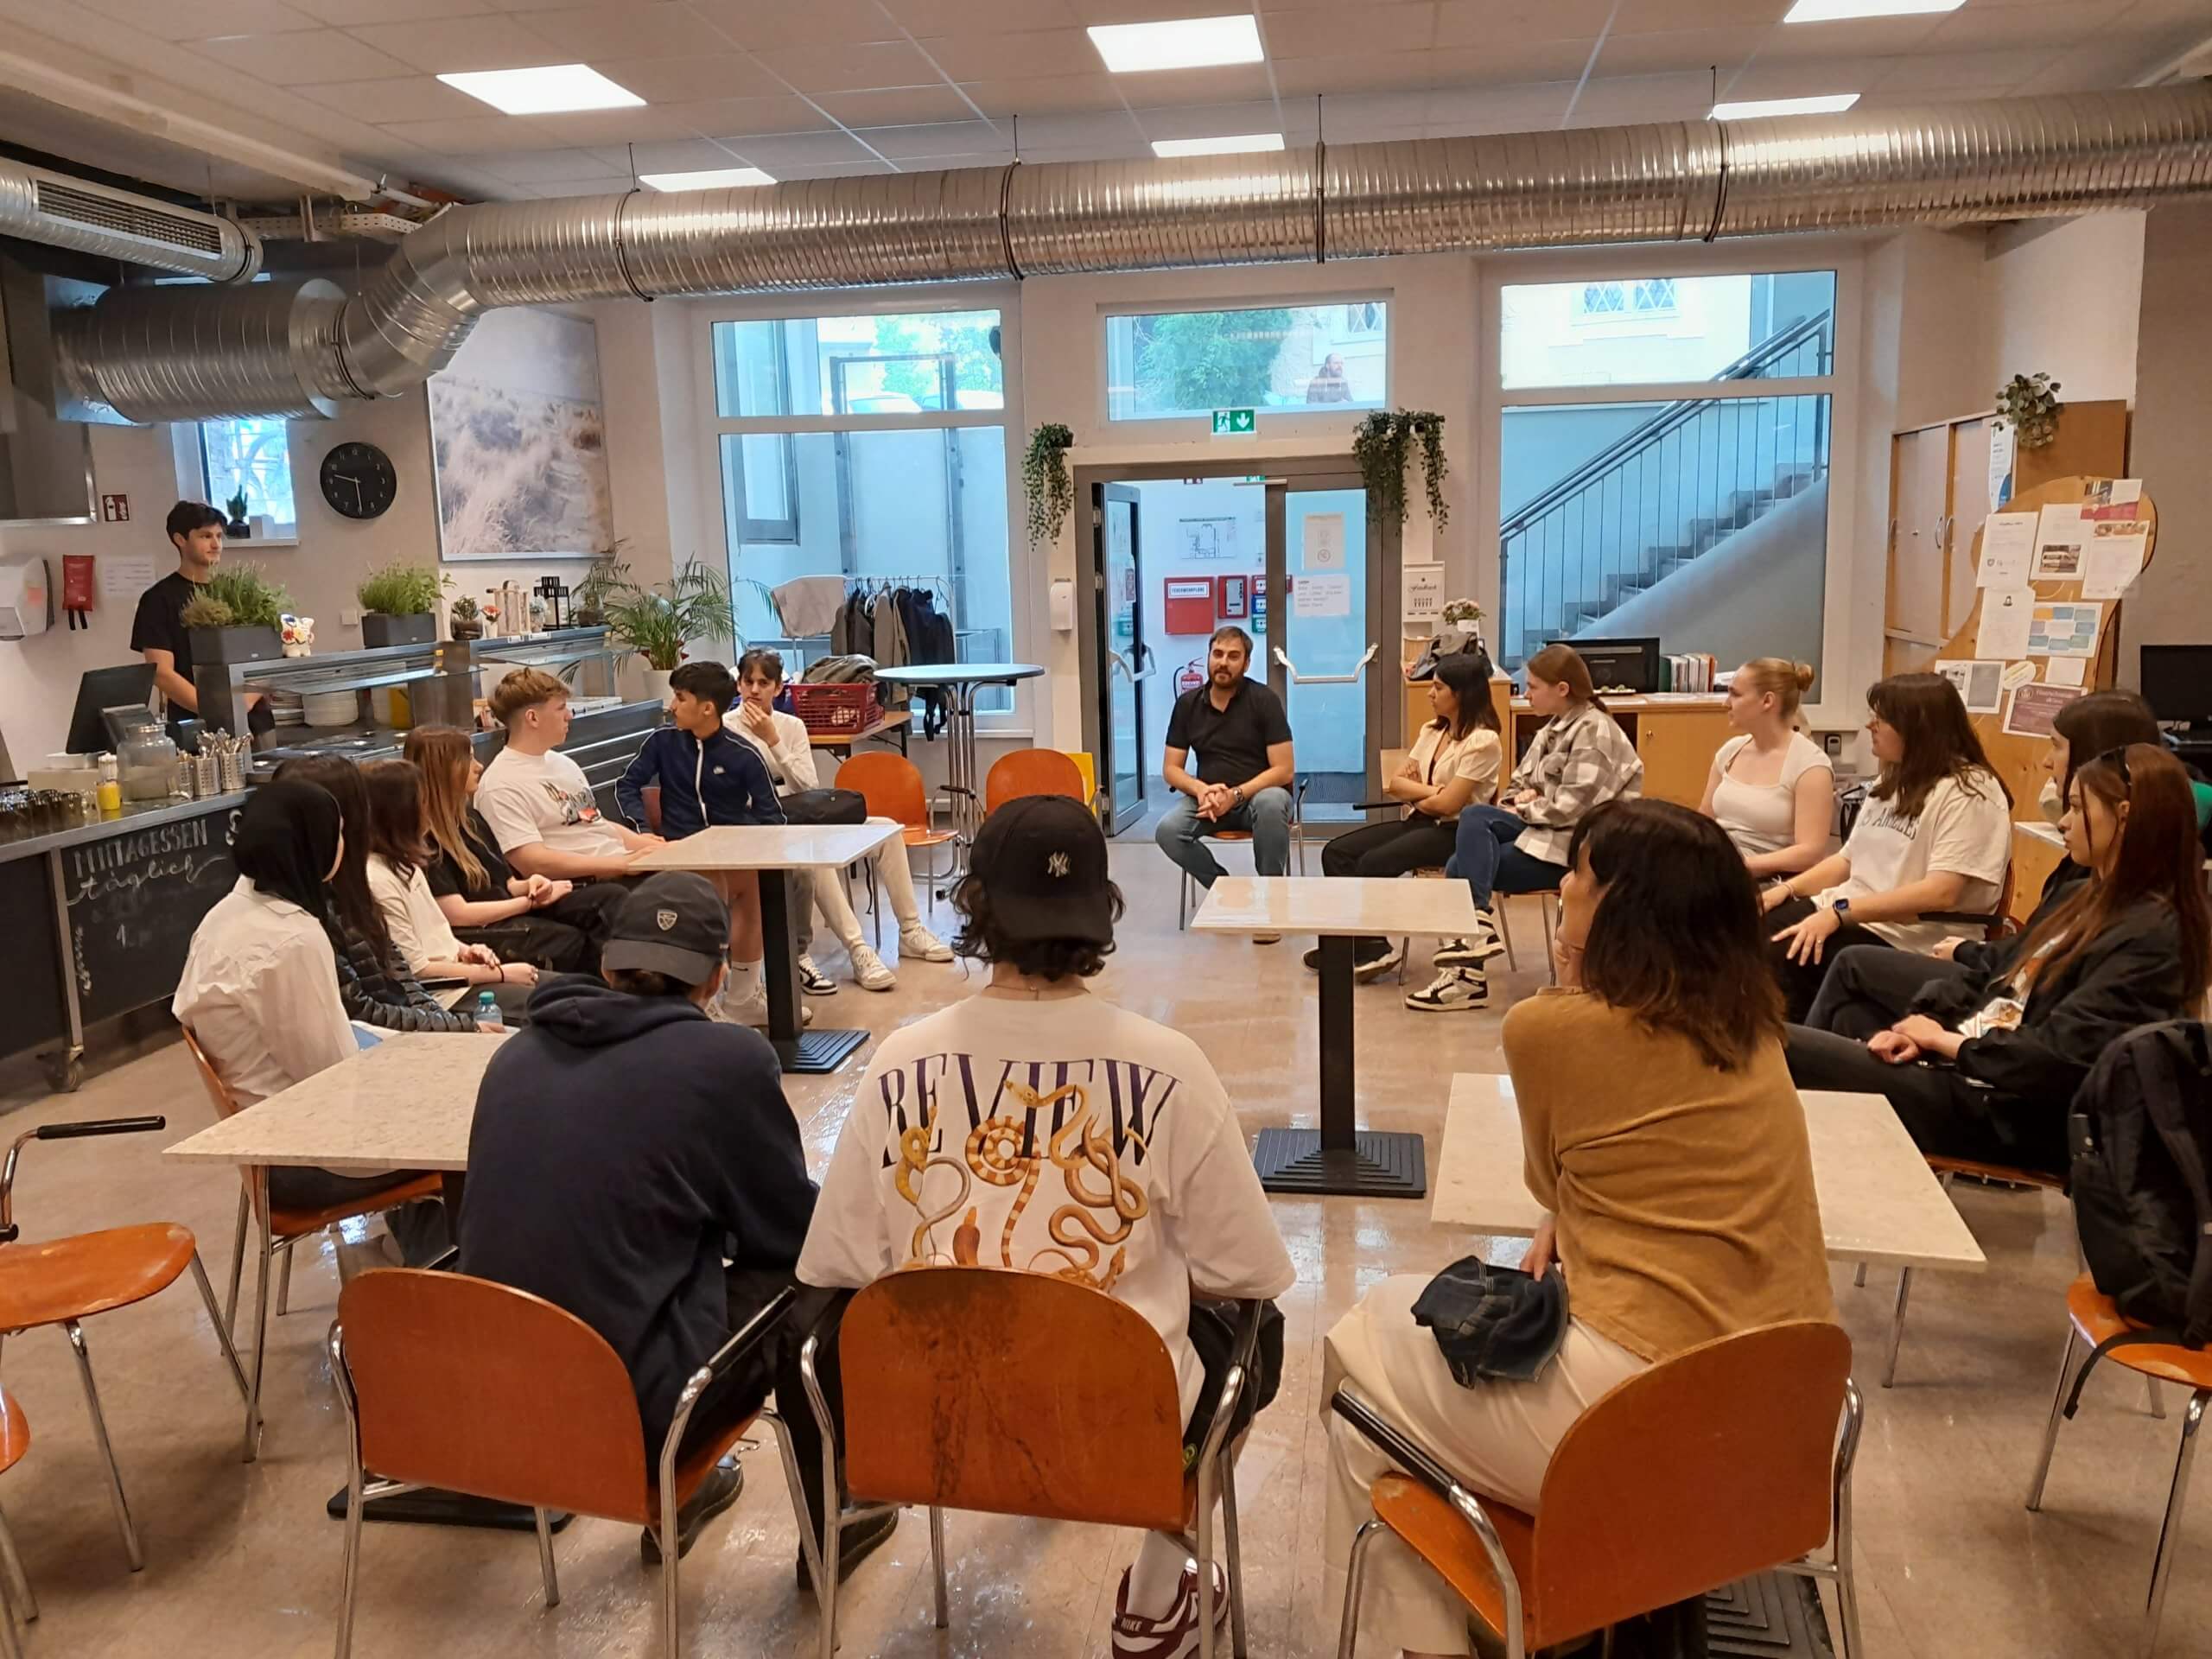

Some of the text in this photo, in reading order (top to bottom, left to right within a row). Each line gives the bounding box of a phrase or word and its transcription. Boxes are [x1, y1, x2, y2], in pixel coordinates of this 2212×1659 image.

[1047, 851, 1070, 878] NY
[878, 1052, 1182, 1168] REVIEW
[1121, 1617, 1142, 1632] NIKE
